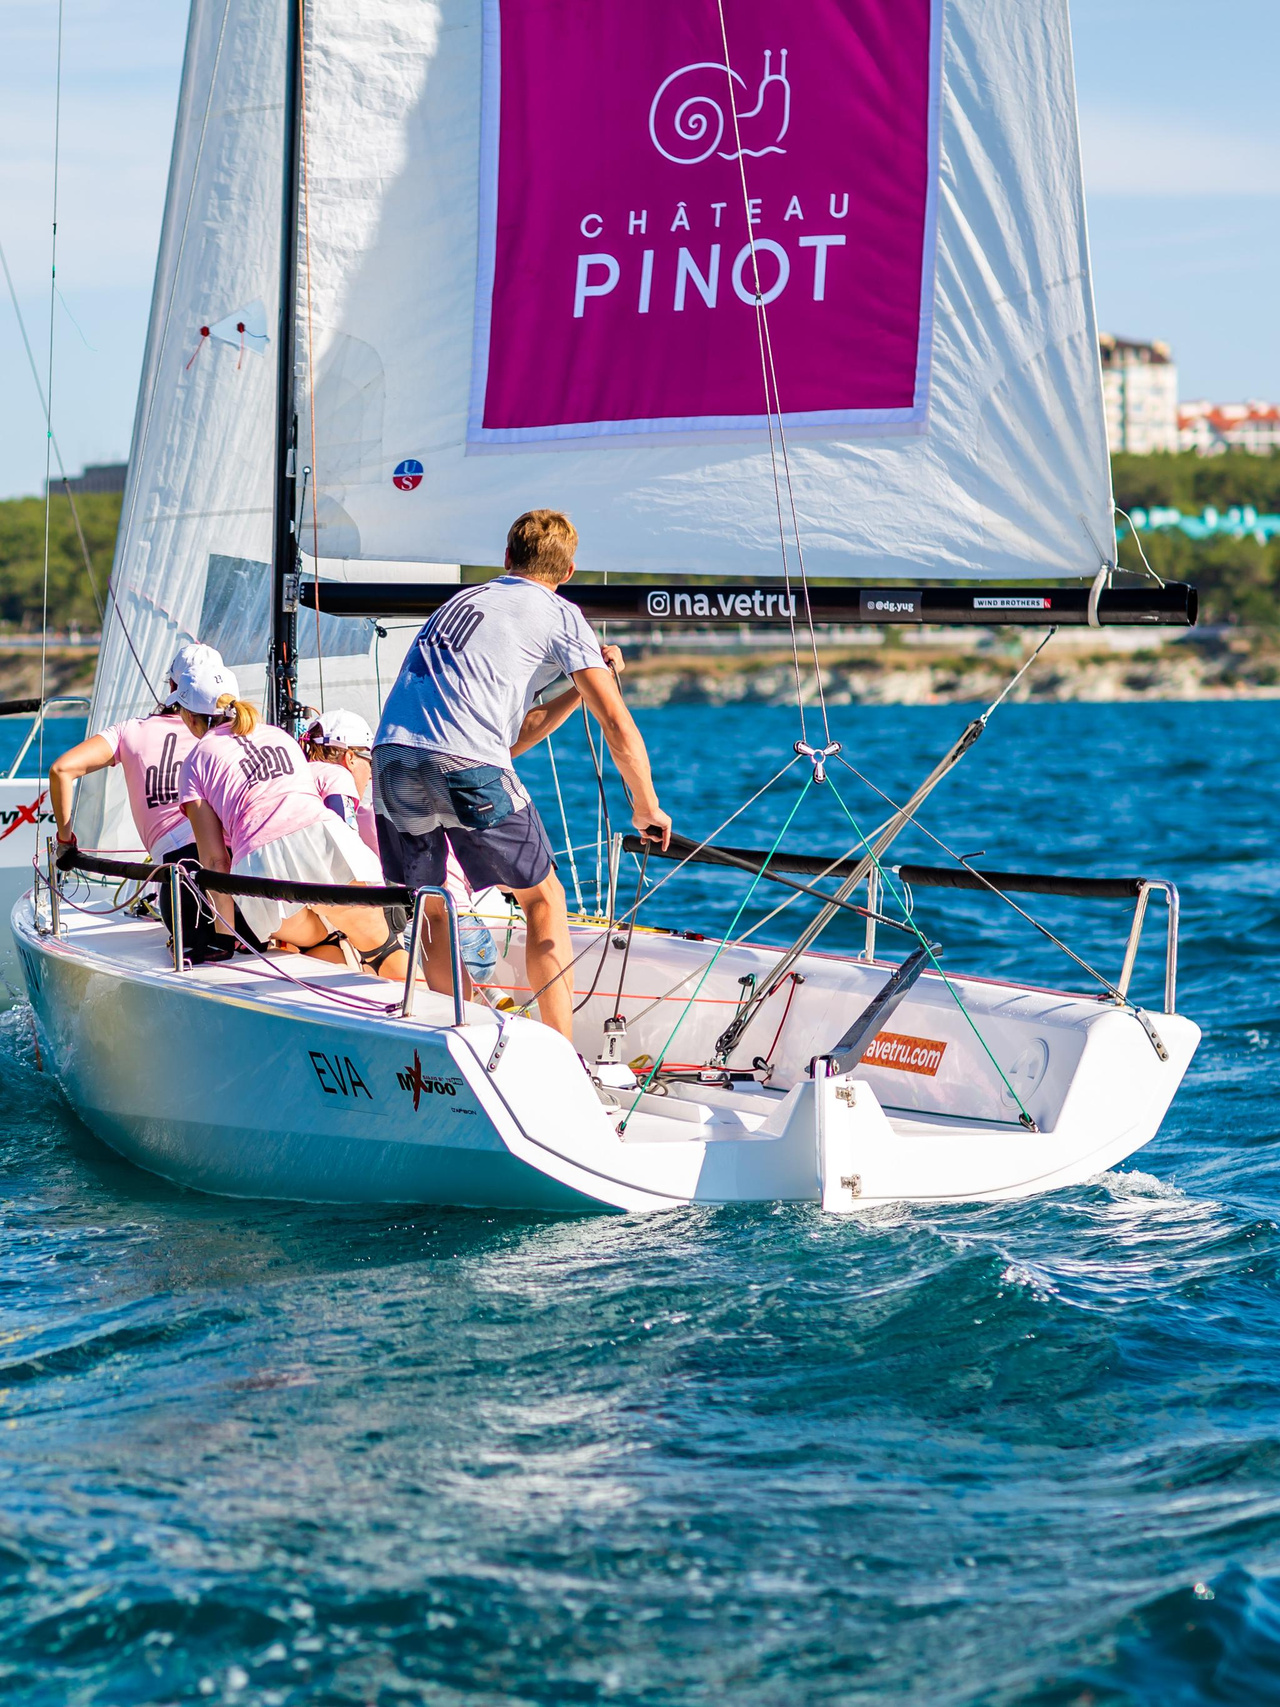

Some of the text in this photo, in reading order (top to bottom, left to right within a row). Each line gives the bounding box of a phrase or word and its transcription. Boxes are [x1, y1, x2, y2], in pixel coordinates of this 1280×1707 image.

[580, 193, 849, 238] CHÂTEAU
[573, 235, 846, 318] PINOT
[674, 590, 797, 617] na.vetru
[977, 599, 1041, 607] WIND BROTHERS
[234, 735, 294, 790] 2020
[308, 1050, 373, 1100] EVA
[863, 1039, 941, 1069] avetru.com
